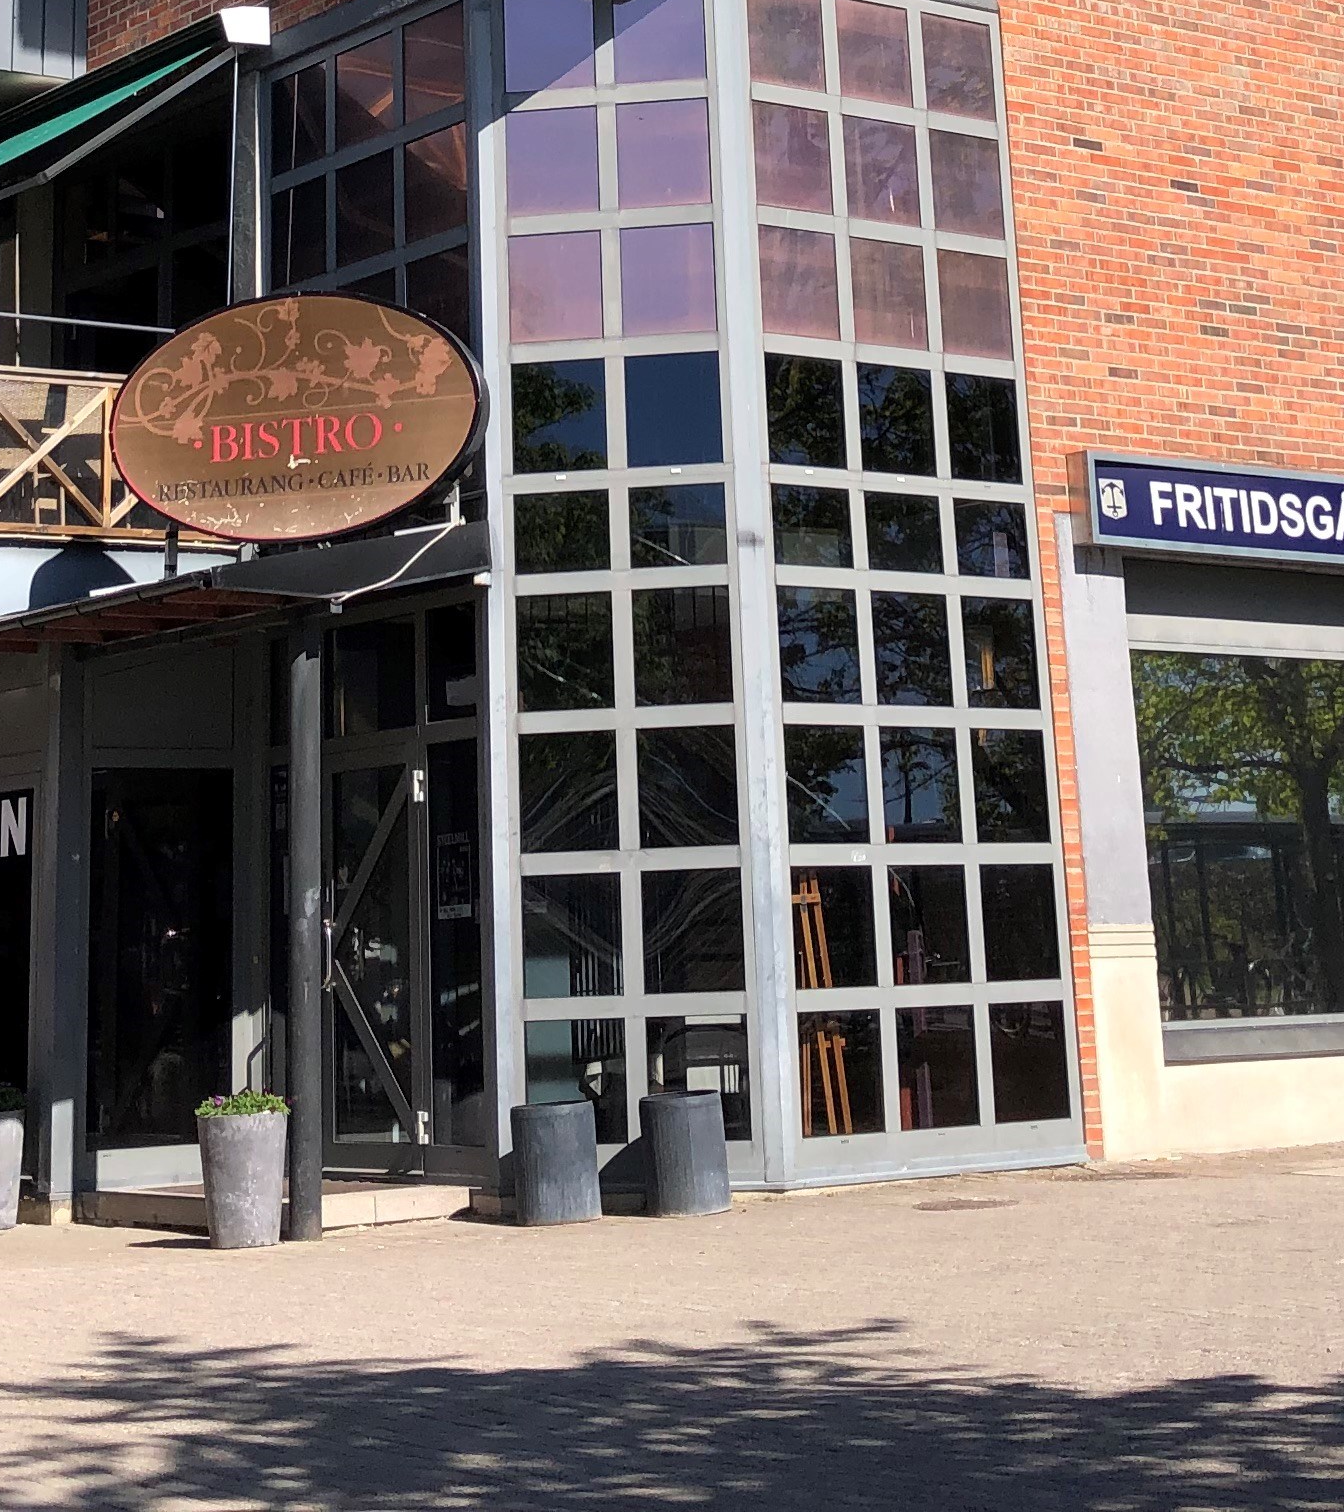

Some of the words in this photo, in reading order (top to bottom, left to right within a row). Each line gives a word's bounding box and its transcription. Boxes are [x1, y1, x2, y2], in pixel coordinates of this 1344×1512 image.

[210, 412, 383, 463] BISTRO
[158, 472, 304, 503] RESTAURANG
[317, 462, 374, 490] CAFÉ
[386, 462, 430, 484] BAR
